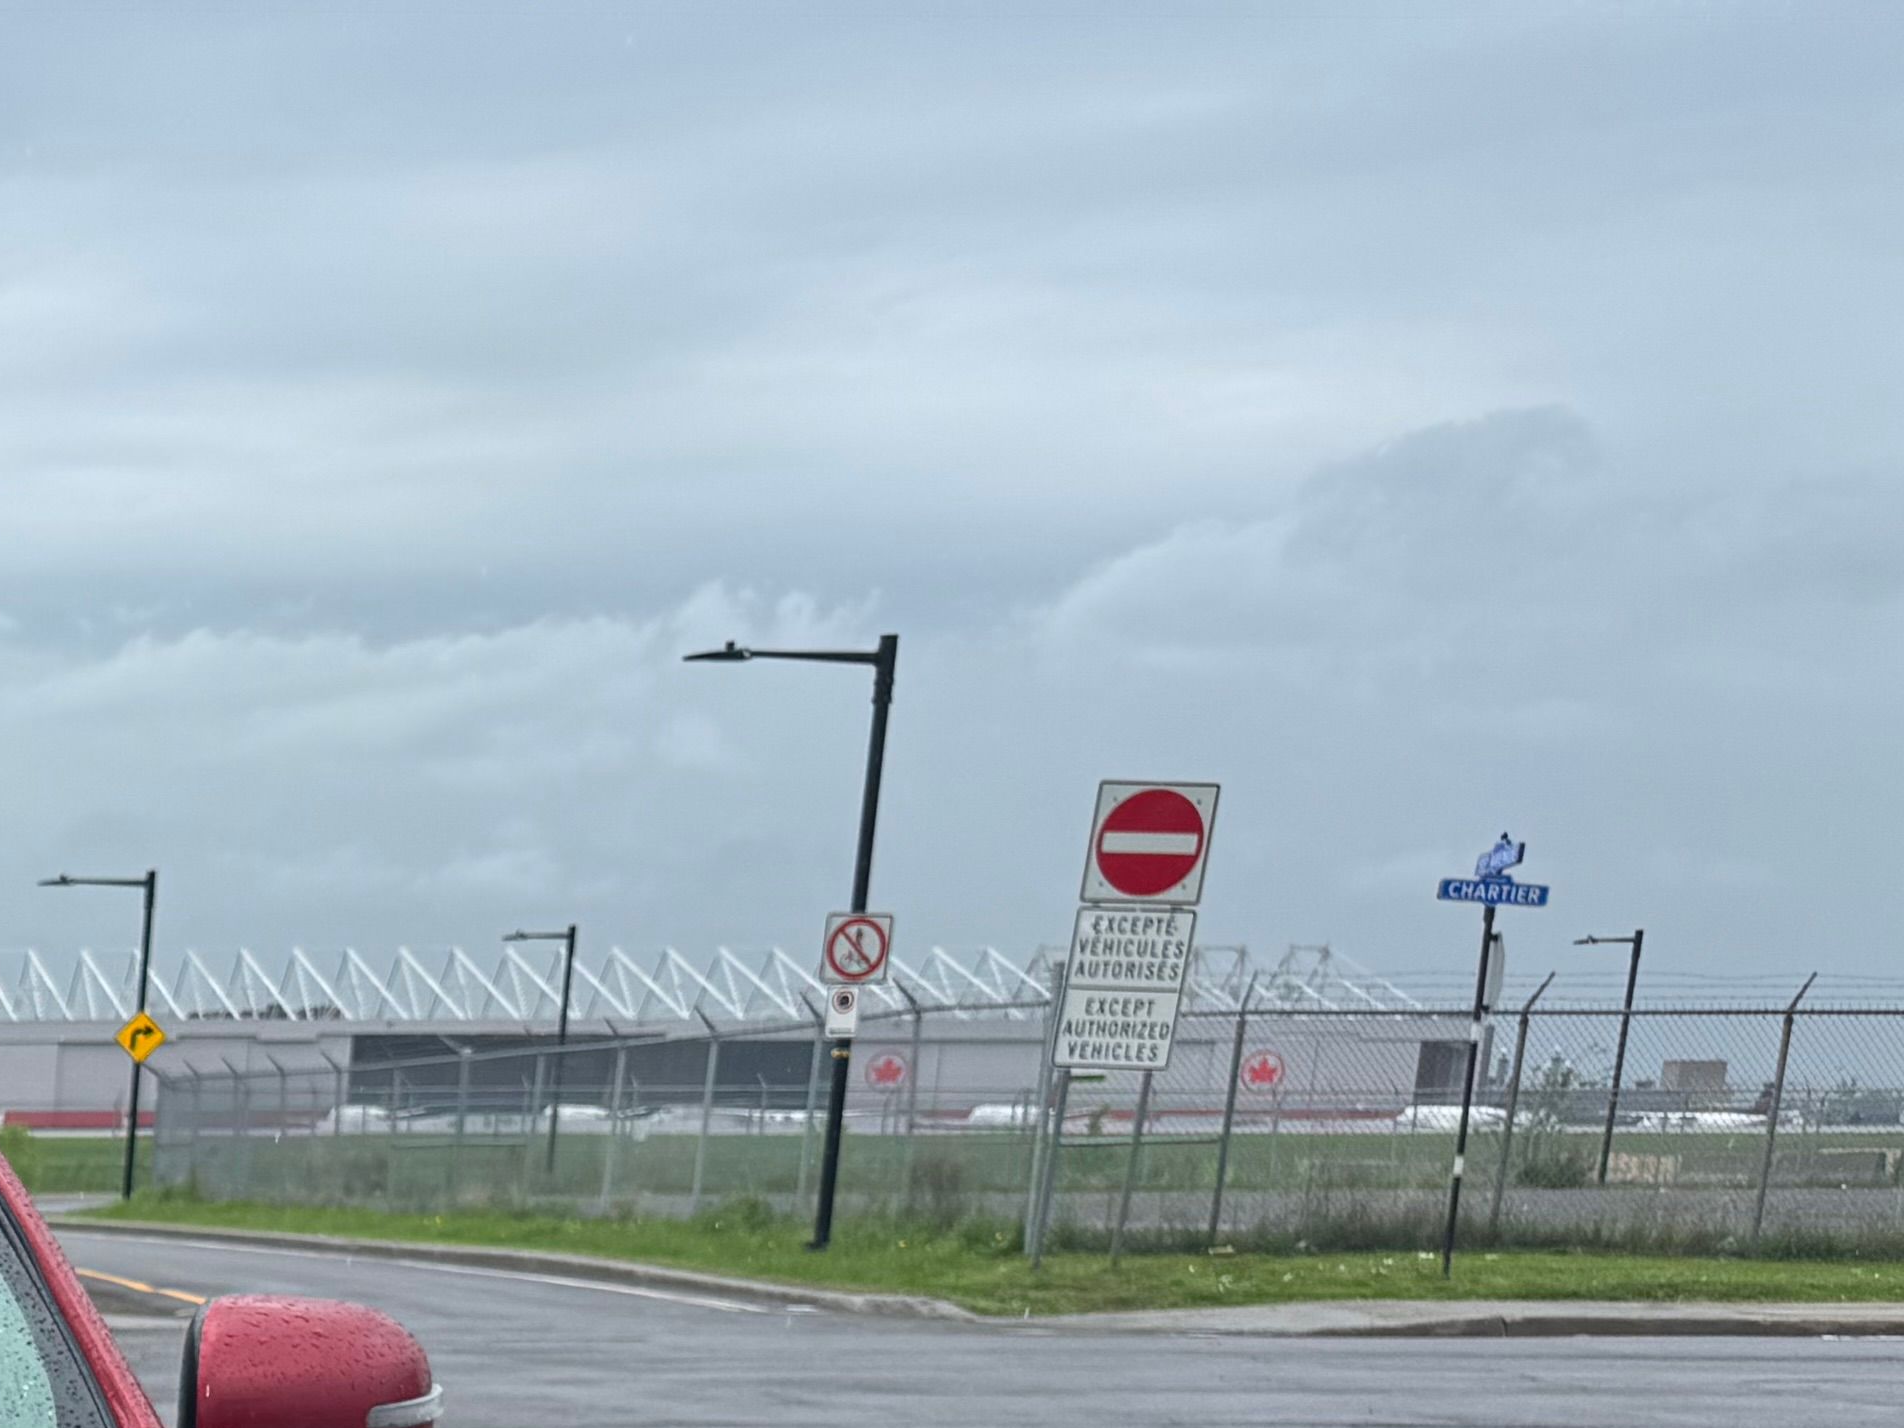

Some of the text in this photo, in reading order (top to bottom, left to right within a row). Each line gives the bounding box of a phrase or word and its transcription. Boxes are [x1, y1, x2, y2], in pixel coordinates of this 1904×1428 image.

[1448, 882, 1541, 904] CHARTIER
[1093, 914, 1177, 937] EXCEPTÉ
[1079, 936, 1185, 959] VÉHICULES
[1075, 959, 1180, 981] AUTORISÉS
[1085, 996, 1155, 1018] EXCEPT
[1062, 1018, 1170, 1040] AUTHORIZED
[1068, 1040, 1159, 1062] VEHICLES
